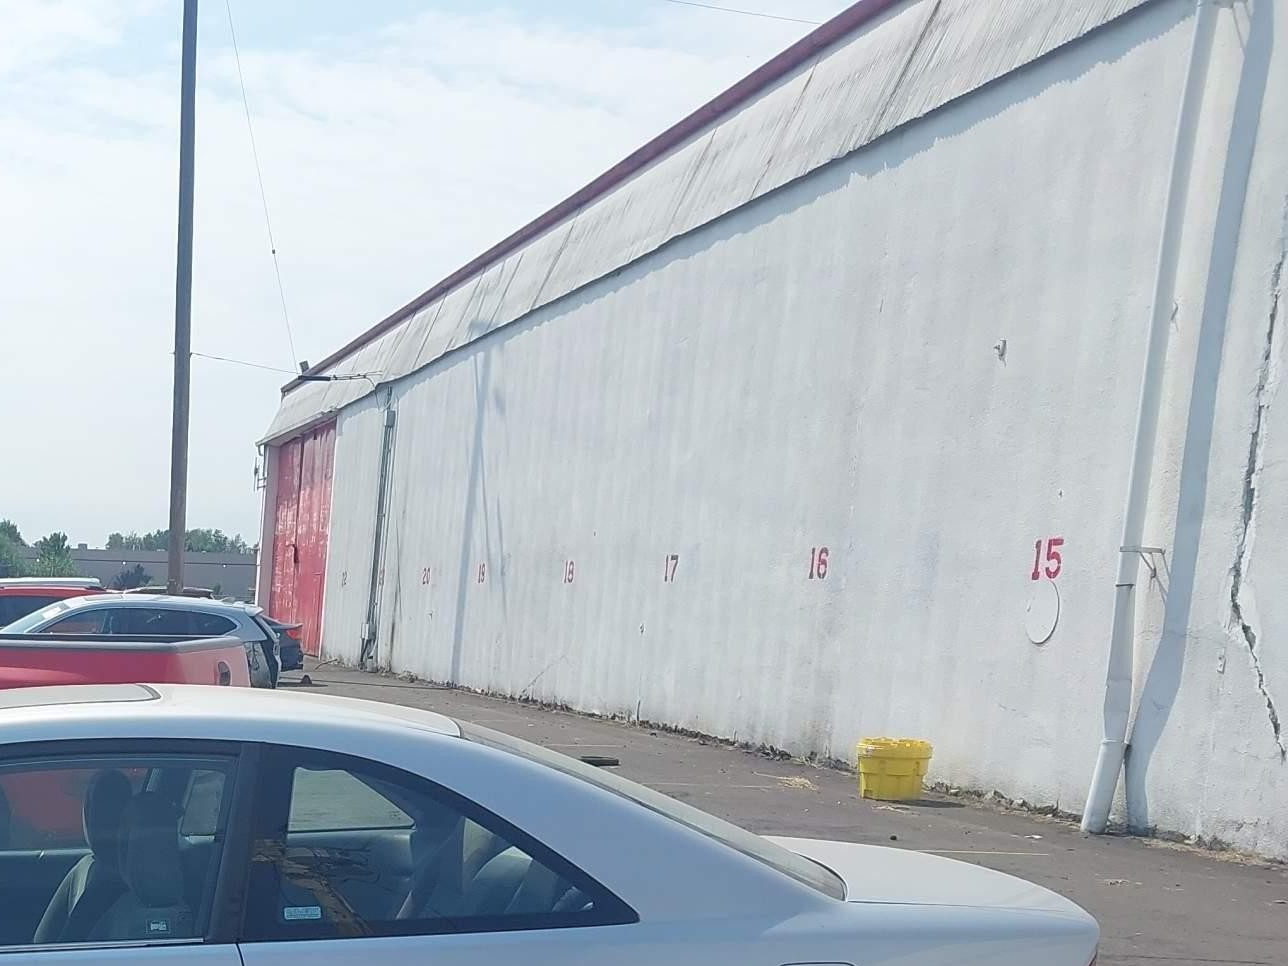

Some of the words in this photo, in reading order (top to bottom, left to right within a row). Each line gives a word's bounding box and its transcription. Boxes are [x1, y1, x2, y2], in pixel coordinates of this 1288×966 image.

[477, 562, 486, 584] 19
[563, 559, 575, 584] 18
[663, 553, 679, 583] 17
[808, 546, 829, 580] 16
[1031, 538, 1065, 581] 15
[421, 566, 432, 585] 20
